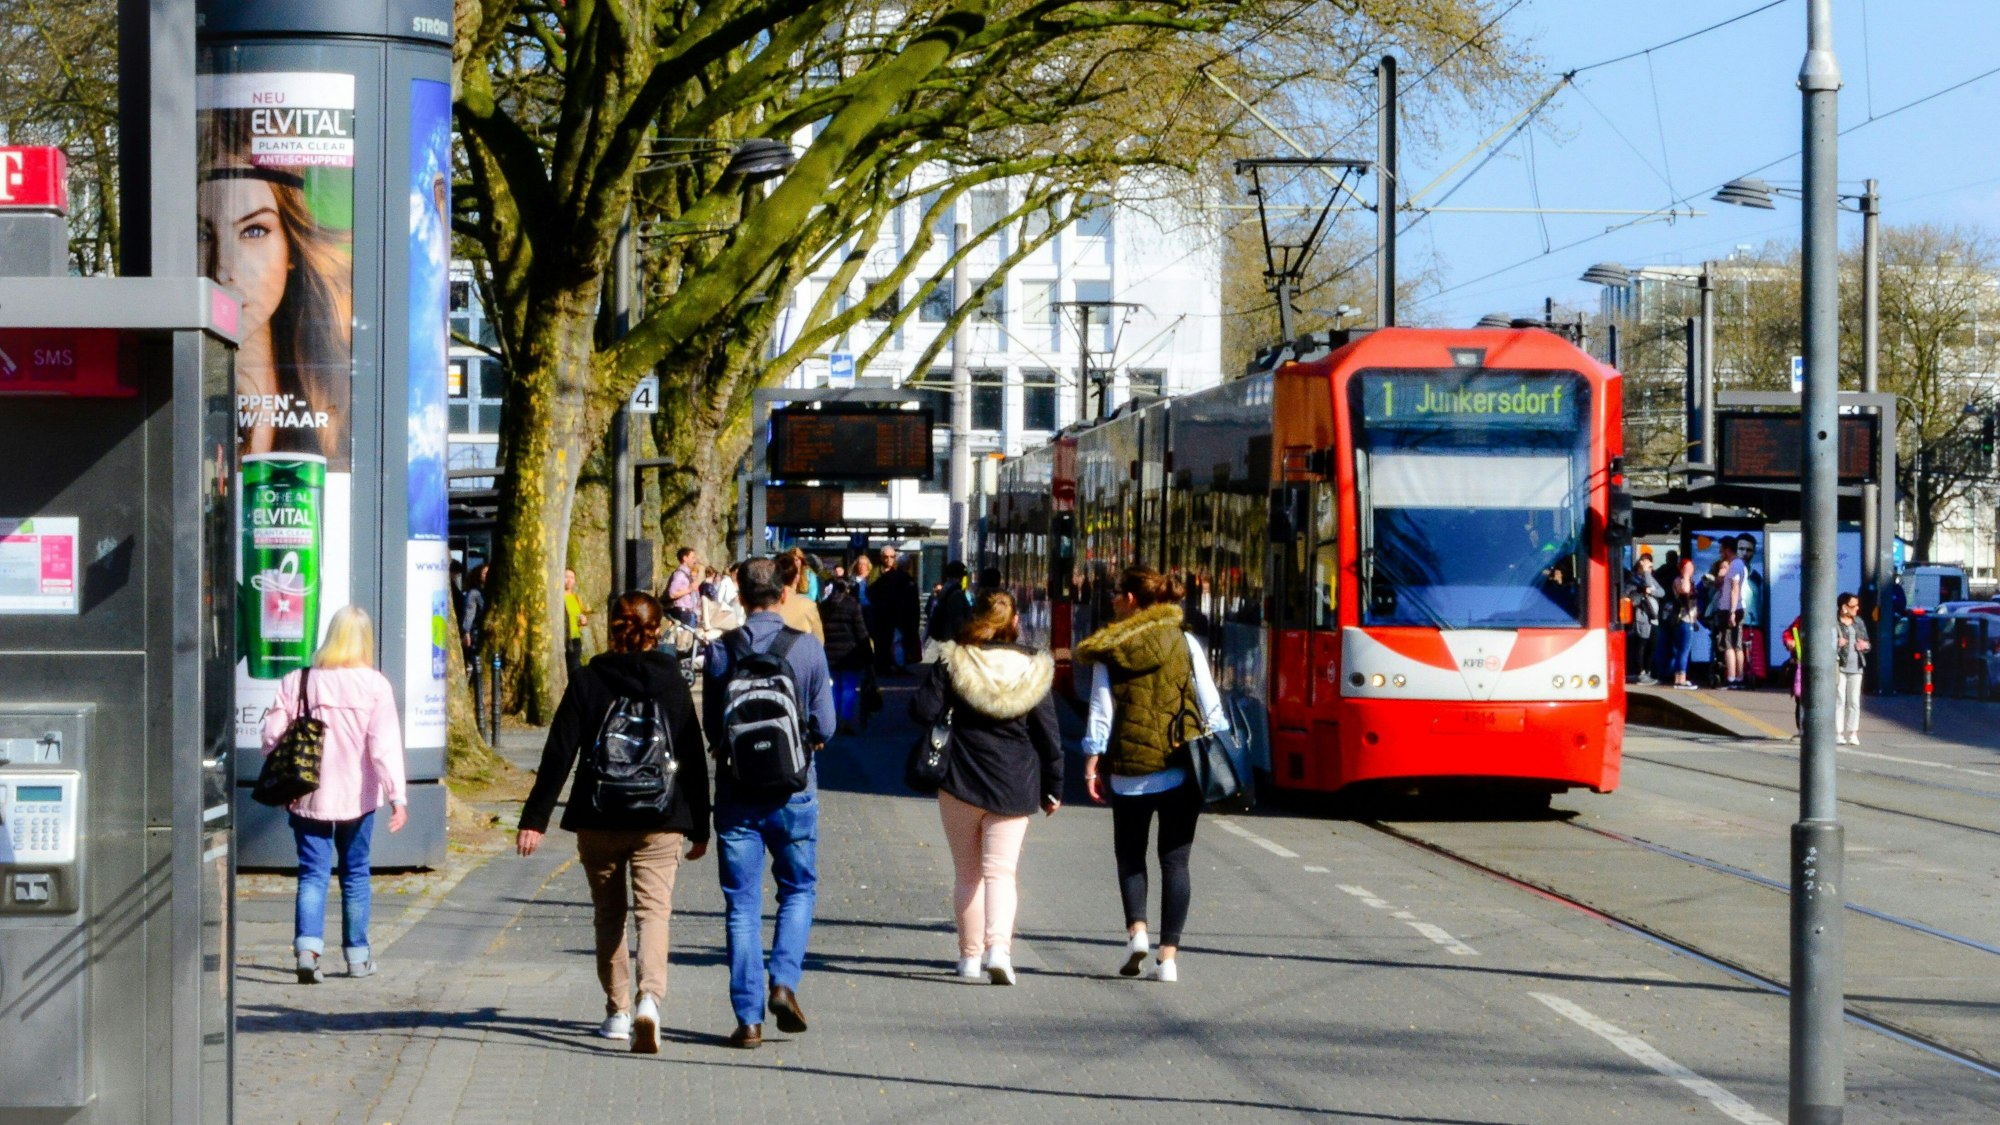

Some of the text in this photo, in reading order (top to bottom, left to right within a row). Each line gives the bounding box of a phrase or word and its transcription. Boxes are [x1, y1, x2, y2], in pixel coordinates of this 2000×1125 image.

[252, 92, 285, 104] NEU
[251, 109, 347, 136] ELVITAL
[258, 141, 346, 151] PLANTA CLEAR
[258, 155, 347, 165] ANTI-SCHUPPEN
[33, 349, 73, 366] SMS
[636, 388, 653, 408] 4
[1383, 381, 1563, 417] 1 Junkersdorf
[253, 507, 313, 526] ELVITAL
[1463, 658, 1484, 668] KVB
